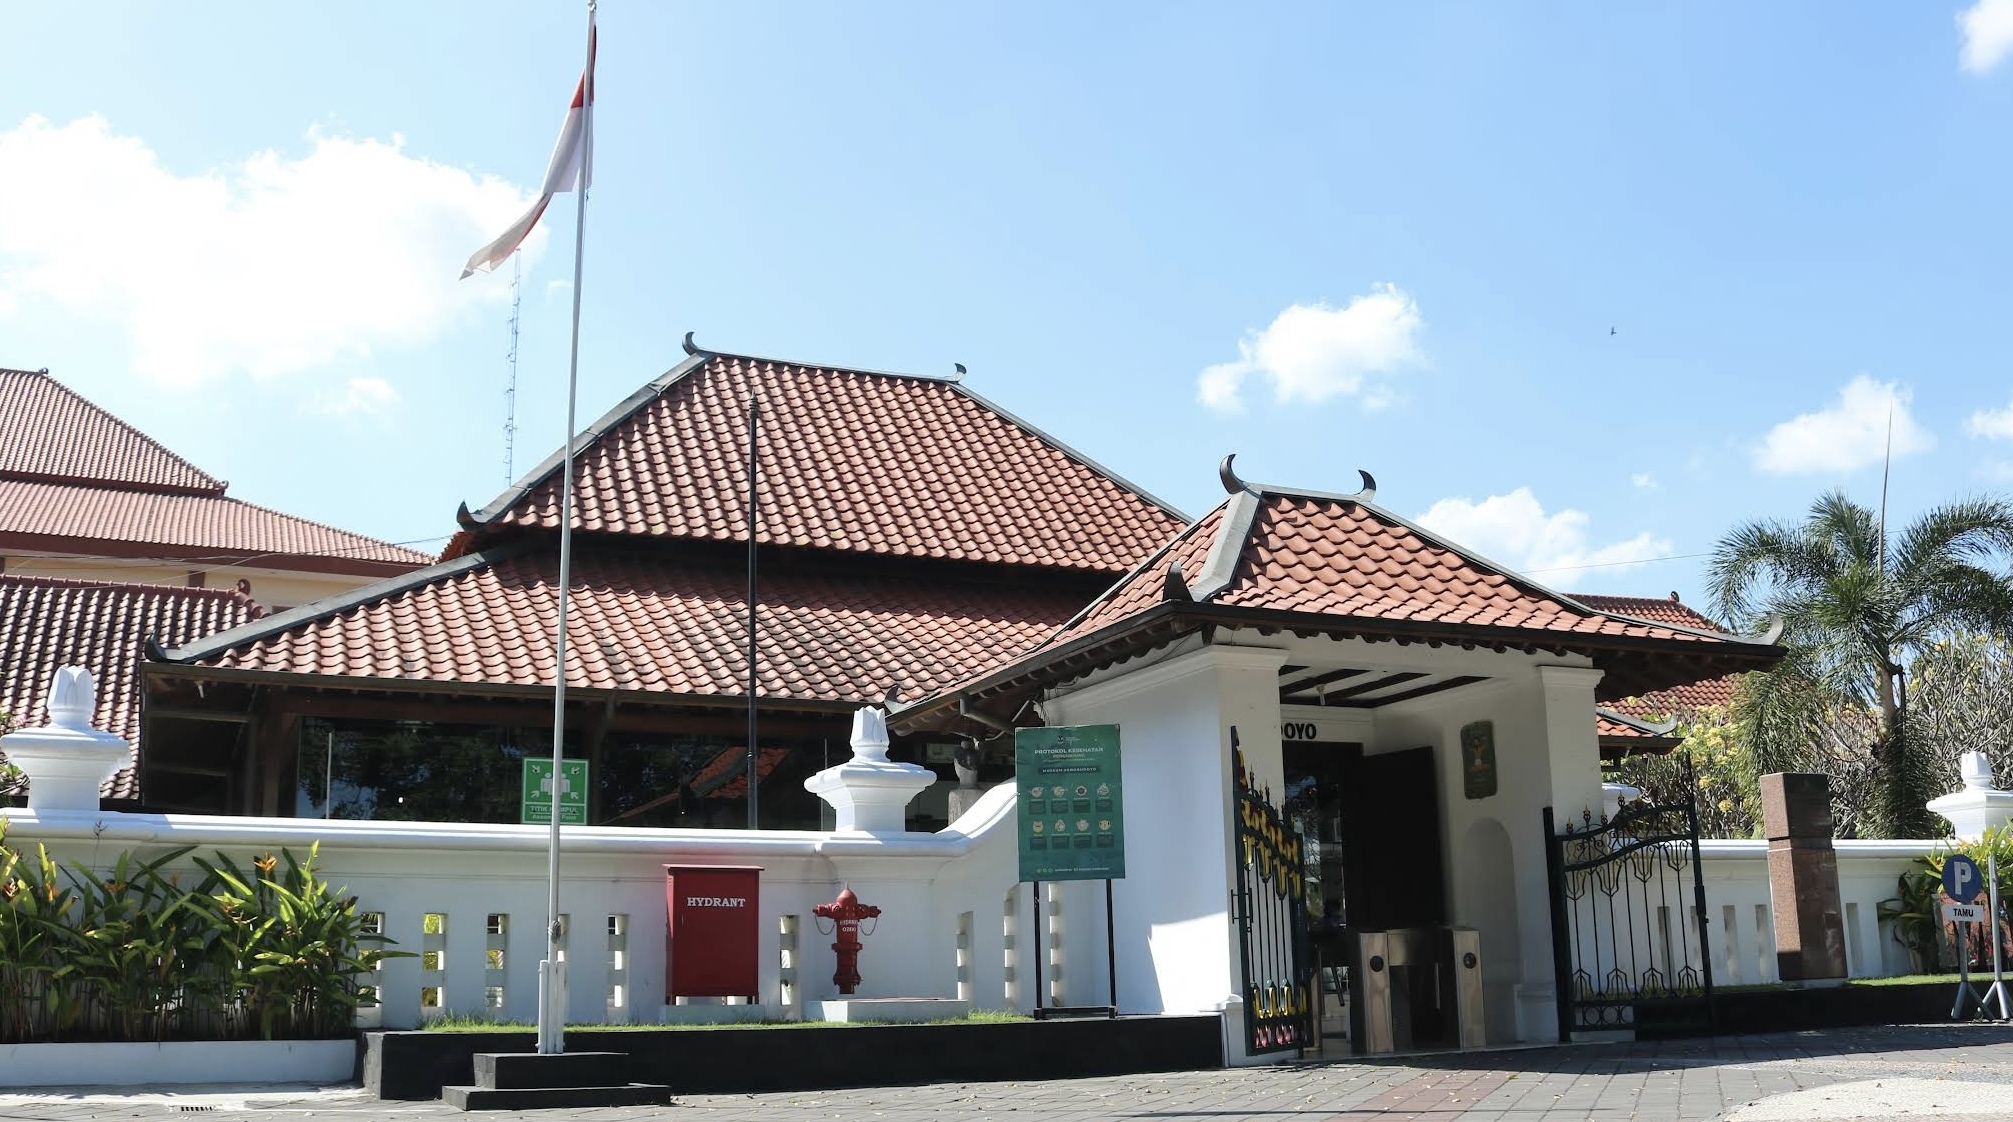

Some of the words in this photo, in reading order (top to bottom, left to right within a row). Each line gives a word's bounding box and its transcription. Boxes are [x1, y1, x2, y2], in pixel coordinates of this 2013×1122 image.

[1281, 723, 1317, 739] OYO
[1954, 861, 1972, 895] P
[686, 896, 746, 907] HYDRANT
[1953, 908, 1974, 917] TAMU
